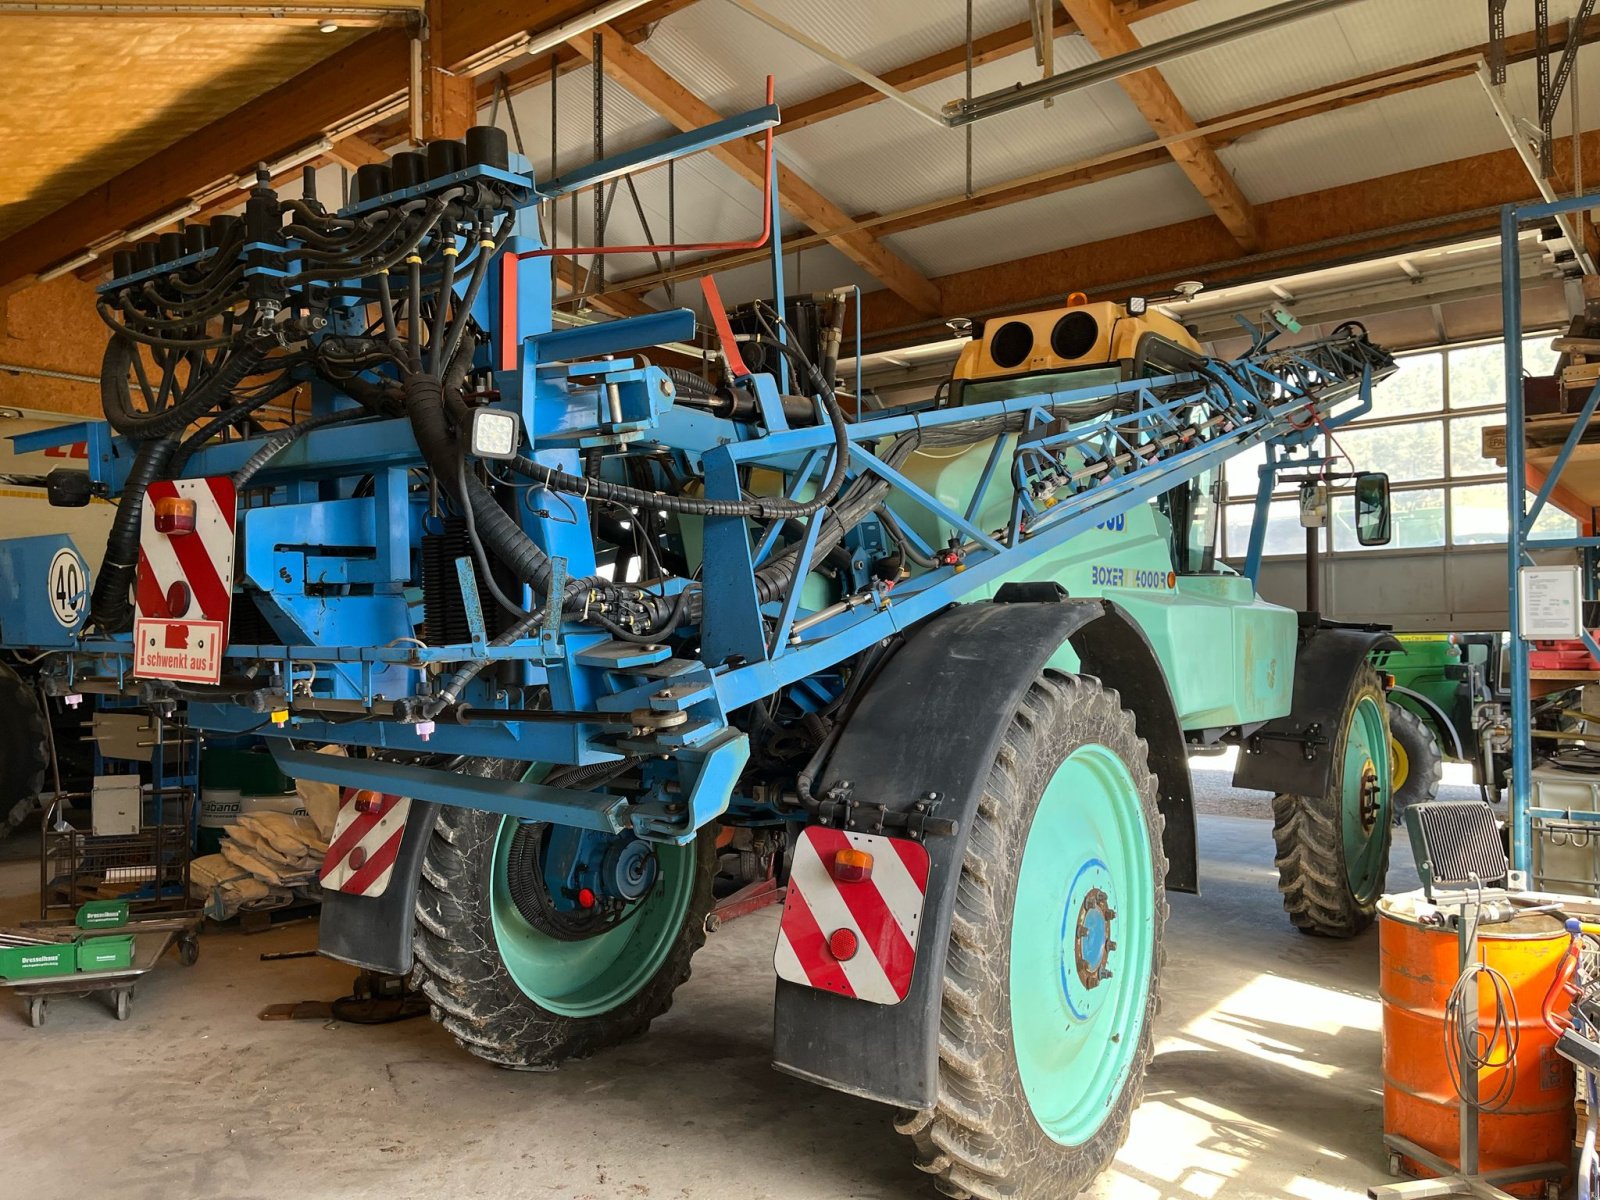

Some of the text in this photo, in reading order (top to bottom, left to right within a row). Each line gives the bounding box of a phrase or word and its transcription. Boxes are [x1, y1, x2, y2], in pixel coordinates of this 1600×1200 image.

[56, 564, 78, 610] 40
[1092, 566, 1124, 587] BOXER
[146, 651, 187, 669] schwenkt
[190, 657, 207, 671] aus
